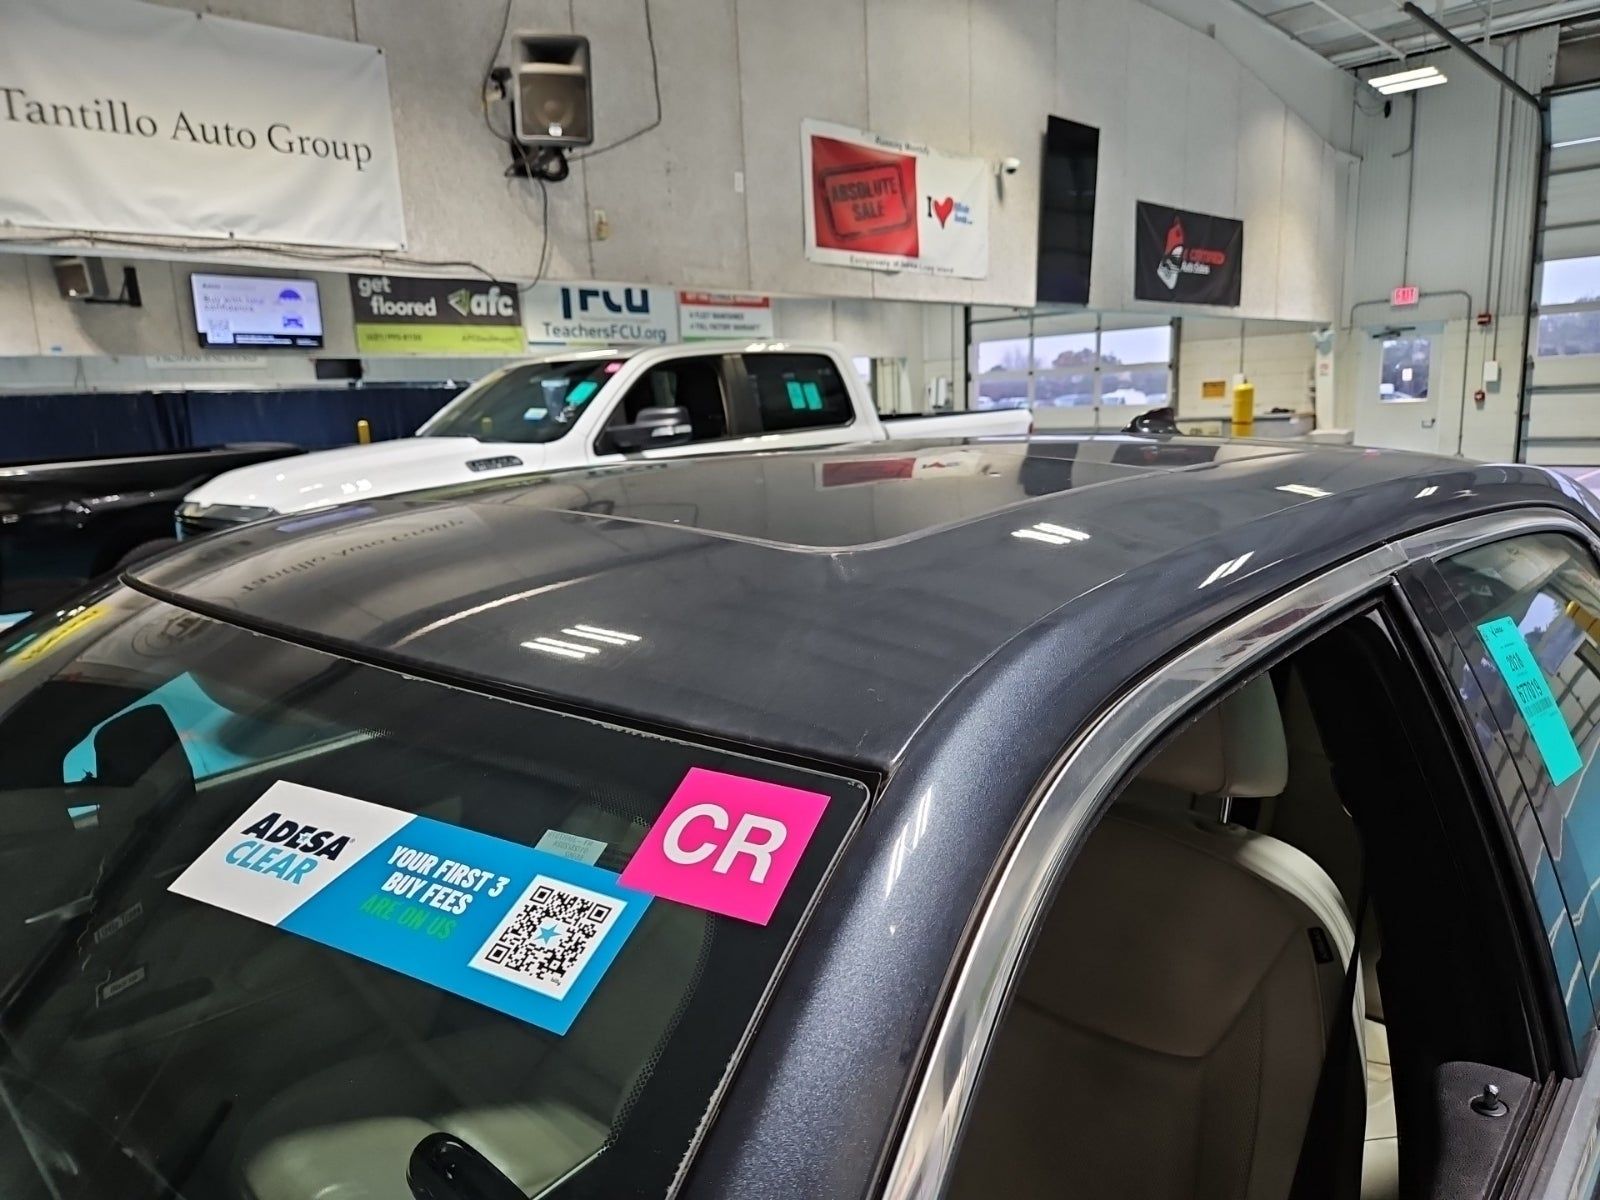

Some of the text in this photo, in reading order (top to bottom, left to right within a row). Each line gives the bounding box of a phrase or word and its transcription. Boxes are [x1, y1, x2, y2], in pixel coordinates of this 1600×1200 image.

[0, 86, 372, 171] Tantillo Auto Group
[831, 176, 898, 203] ABSOLUTE
[927, 195, 933, 218] I
[851, 201, 886, 222] SALE
[358, 276, 391, 297] get
[470, 286, 515, 317] afc
[370, 295, 438, 317] floored
[543, 321, 667, 343] TeachersFCU.org
[240, 811, 352, 861] ADESA
[662, 803, 788, 884] CR
[224, 840, 319, 885] CLEAR
[387, 845, 511, 898] YOUR FIRST 3
[381, 871, 474, 915] BUY FEES
[359, 894, 458, 941] ARE ON US
